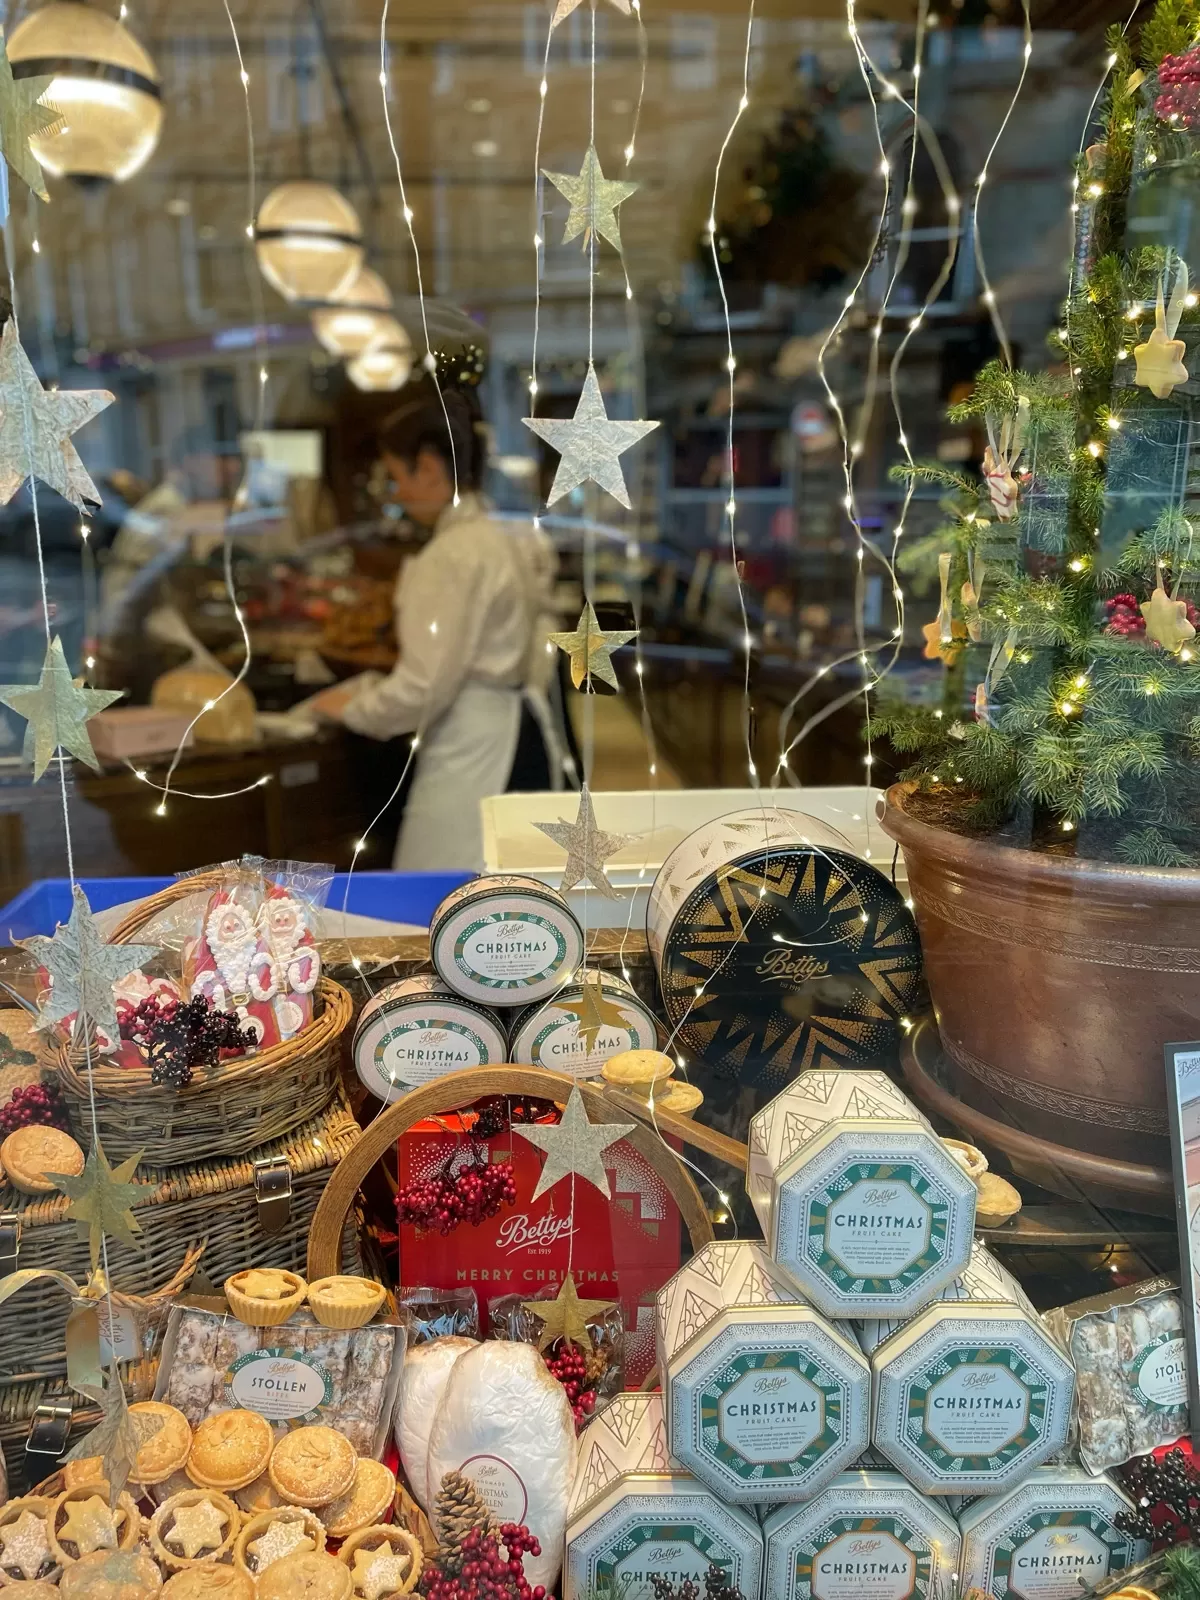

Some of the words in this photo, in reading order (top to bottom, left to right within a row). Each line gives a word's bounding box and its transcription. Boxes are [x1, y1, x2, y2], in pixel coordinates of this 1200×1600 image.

[497, 923, 525, 939] Bettys
[476, 941, 547, 953] CHRISTMAS
[755, 948, 830, 983] Bettys
[419, 1031, 448, 1044] Bettys
[551, 1037, 621, 1055] CHRITMAS
[396, 1049, 469, 1061] CHRISTMAS
[863, 1189, 898, 1204] Bettys
[834, 1215, 923, 1229] CHRISTMAS
[496, 1213, 573, 1247] Bettys
[457, 1269, 514, 1281] MERRY
[268, 1361, 296, 1375] Bettys
[1155, 1361, 1186, 1379] STOLL
[251, 1377, 307, 1393] STOLLEN
[753, 1376, 787, 1392] Bettys
[961, 1372, 997, 1387] Bettys
[727, 1400, 816, 1417] CHRISTMAS
[933, 1397, 1022, 1409] CHRISTMAS
[476, 1488, 509, 1498] RISTMAS
[848, 1540, 881, 1553] Bettys
[648, 1547, 682, 1561] Bettys
[1018, 1554, 1103, 1568] CHRISTMAS
[820, 1563, 908, 1574] CHRISTMAS
[621, 1571, 708, 1582] CHRSTMAS
